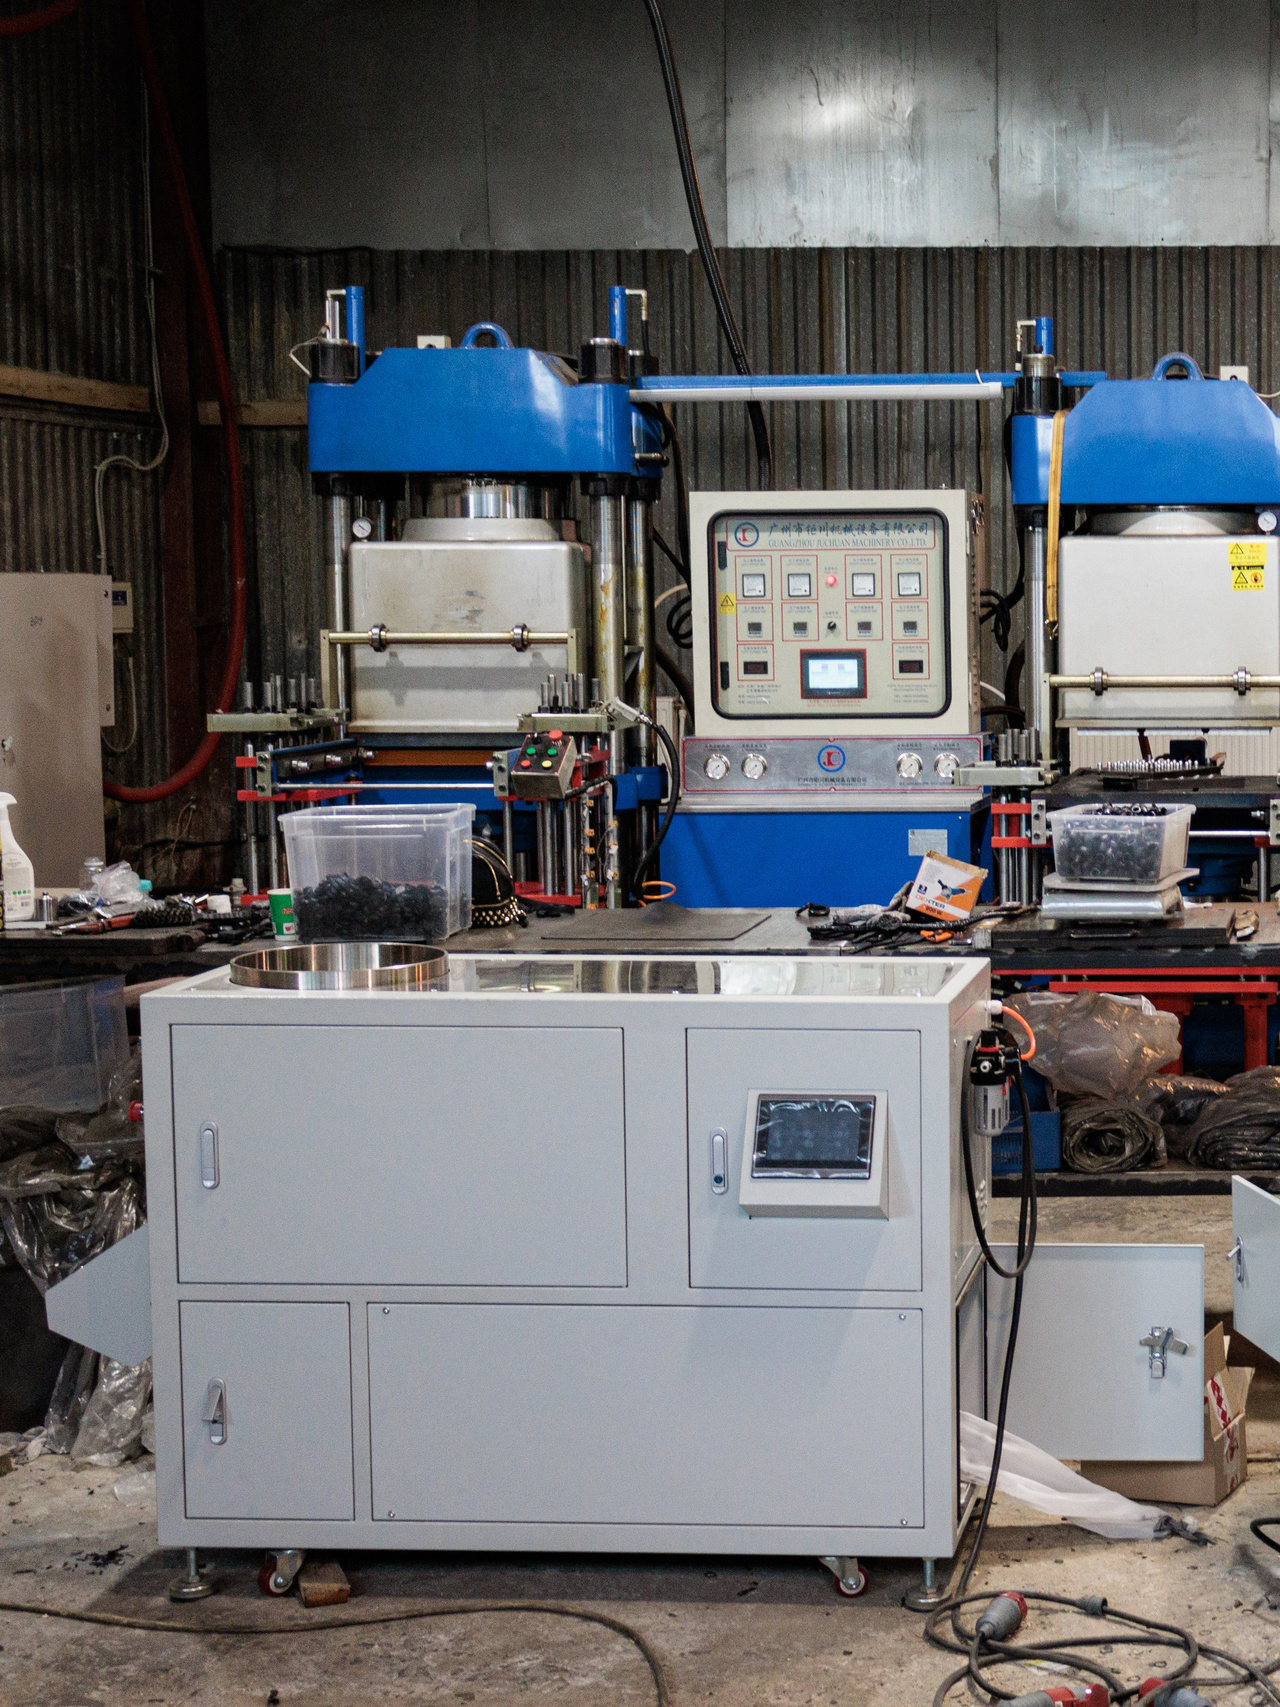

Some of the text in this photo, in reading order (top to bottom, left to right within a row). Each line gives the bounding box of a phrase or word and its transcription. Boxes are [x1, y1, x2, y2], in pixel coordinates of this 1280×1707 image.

[768, 539, 815, 549] GUANGZHOU
[852, 538, 895, 547] MACHINERY
[915, 895, 945, 909] DEXTER
